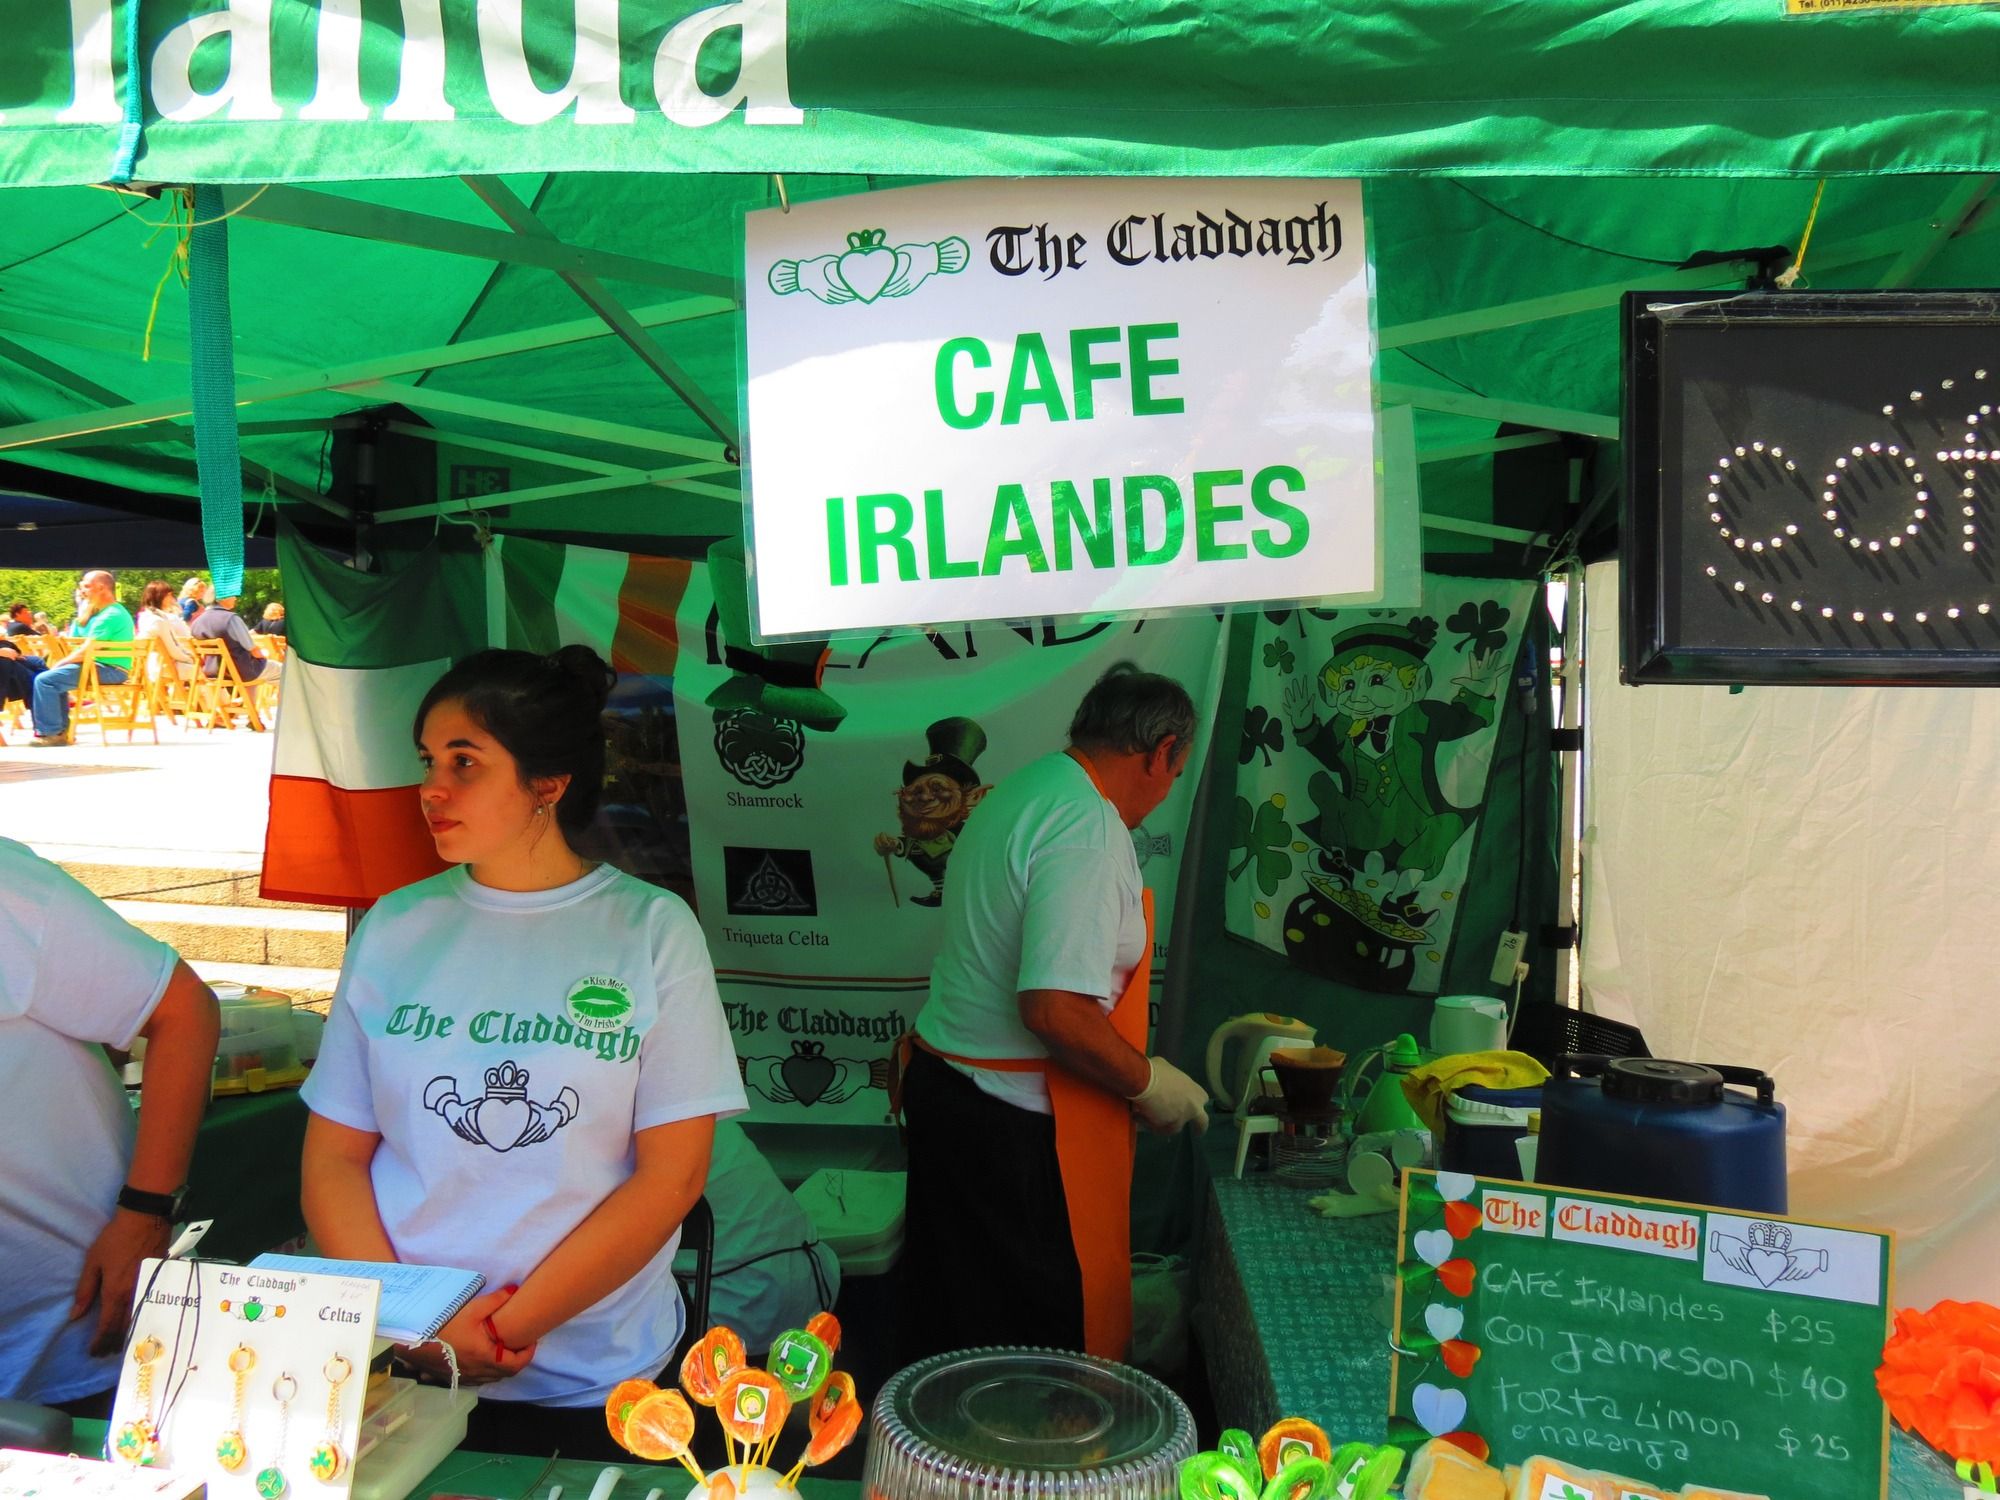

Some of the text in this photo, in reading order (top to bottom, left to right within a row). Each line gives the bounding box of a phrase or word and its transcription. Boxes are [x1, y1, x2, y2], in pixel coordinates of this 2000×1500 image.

[985, 200, 1343, 282] The Claddagh
[934, 322, 1185, 430] CAFE
[825, 465, 1310, 587] IRLANDES
[726, 791, 804, 809] Shamrock
[722, 927, 830, 947] Triqueta Celta
[590, 976, 607, 986] Kiss
[385, 1003, 641, 1063] The Claddagh
[594, 1018, 616, 1029] Irish
[722, 1002, 907, 1044] The Claddagh
[1485, 1197, 1697, 1250] The Claddagh
[219, 1272, 297, 1294] The Claddagh
[318, 1305, 362, 1325] Celtas
[1761, 1308, 1836, 1346] $35
